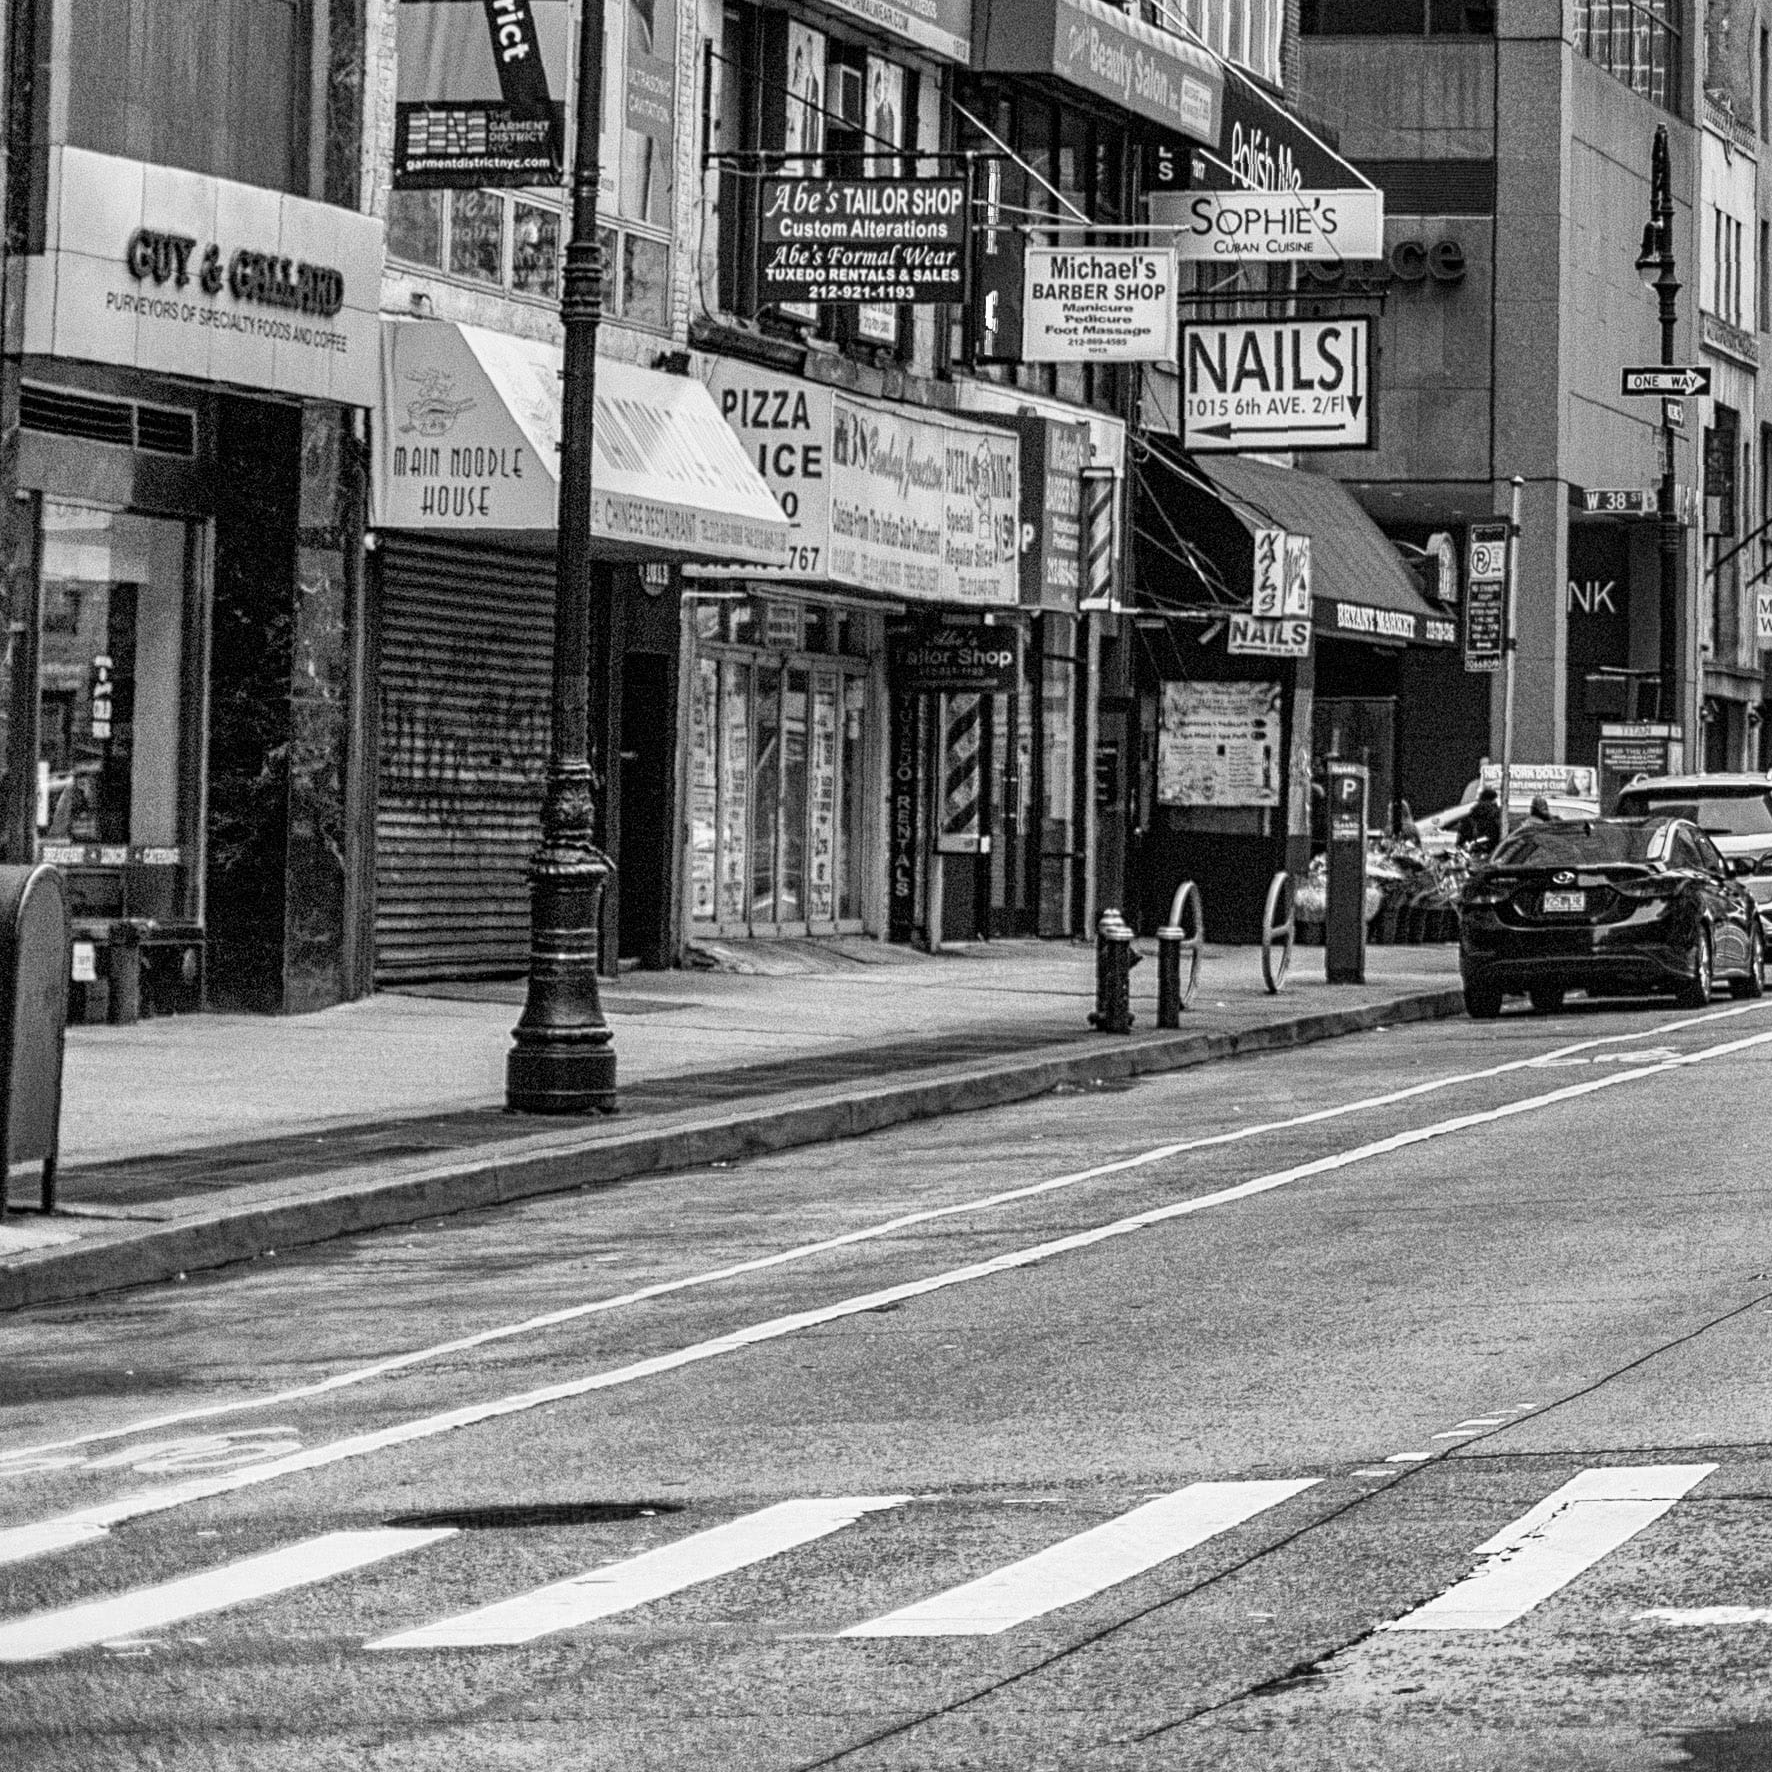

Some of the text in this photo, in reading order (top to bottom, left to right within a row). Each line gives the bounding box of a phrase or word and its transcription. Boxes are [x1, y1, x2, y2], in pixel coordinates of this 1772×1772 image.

[489, 120, 550, 131] GARMENT
[489, 132, 545, 142] DISTRICT
[406, 157, 550, 171] garmentdistrictnyc.com
[765, 180, 962, 217] Abe's TAILOR SHOP
[780, 218, 948, 238] Custom Alterations
[126, 228, 197, 289] GUY
[201, 242, 223, 295] &
[769, 244, 956, 267] Abe's Formal Wear
[766, 268, 960, 282] TUXEDO RENTALS & SALES
[1051, 256, 1156, 279] Michael's
[809, 285, 915, 299] 212-921-1193
[1032, 283, 1166, 300] BARBER SHOP
[107, 292, 179, 321] PURVEYORS
[181, 304, 197, 323] OF
[199, 306, 255, 333] SPECIALTY
[256, 319, 291, 341] FOODS
[1062, 303, 1133, 313] Manicure
[1064, 314, 1132, 324] Pedicure
[1045, 325, 1151, 337] Foot Massage
[1189, 327, 1344, 394] NAILS
[1633, 375, 1698, 388] ONE WAY
[722, 389, 810, 429] PIZZA
[1187, 398, 1228, 417] 1015
[1235, 397, 1261, 416] 6th
[1266, 396, 1306, 415] AVE.
[394, 446, 523, 479] MAIN NOODLE
[421, 485, 491, 517] HOUSE
[1586, 493, 1641, 510] W 38 ST
[1337, 603, 1375, 631] BRYANT
[1376, 605, 1415, 638] MARKET
[1231, 620, 1308, 646] NAILS
[959, 649, 1012, 667] Shop
[1536, 769, 1567, 780] DOLLS
